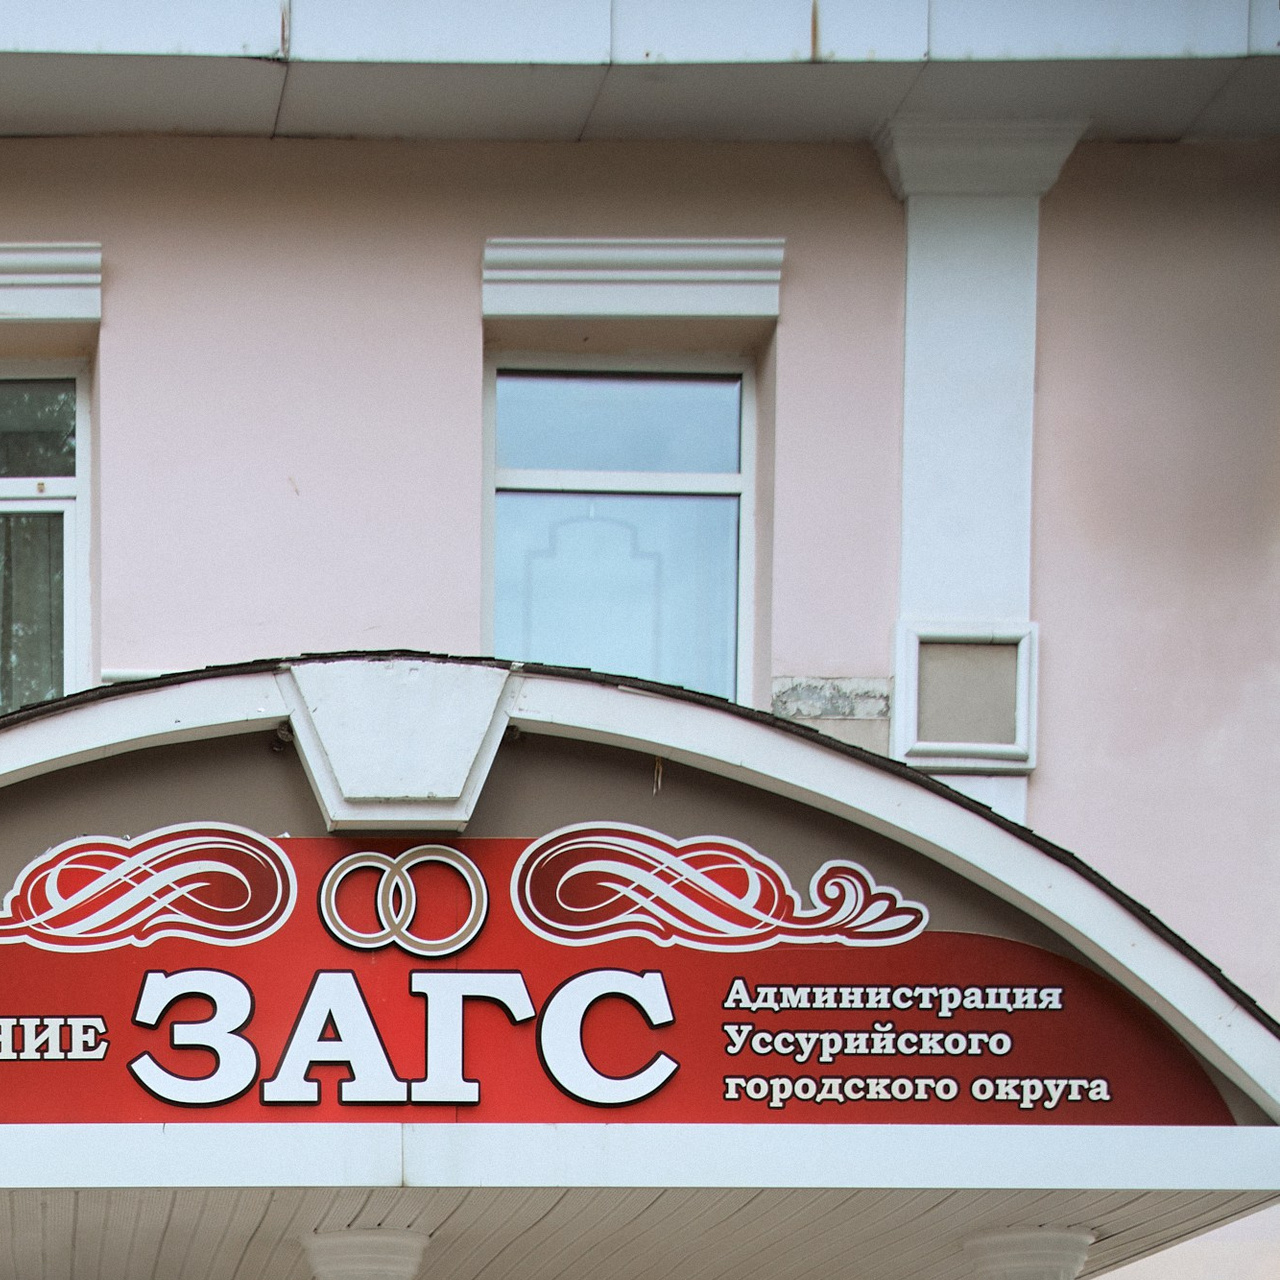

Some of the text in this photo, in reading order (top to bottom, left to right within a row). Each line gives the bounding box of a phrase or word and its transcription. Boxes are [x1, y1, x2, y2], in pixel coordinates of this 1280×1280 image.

[723, 978, 1063, 1017] Администрация
[128, 967, 680, 1105] ЗАГС
[723, 1022, 1013, 1062] Уссурийского
[724, 1075, 1111, 1108] городского округа
